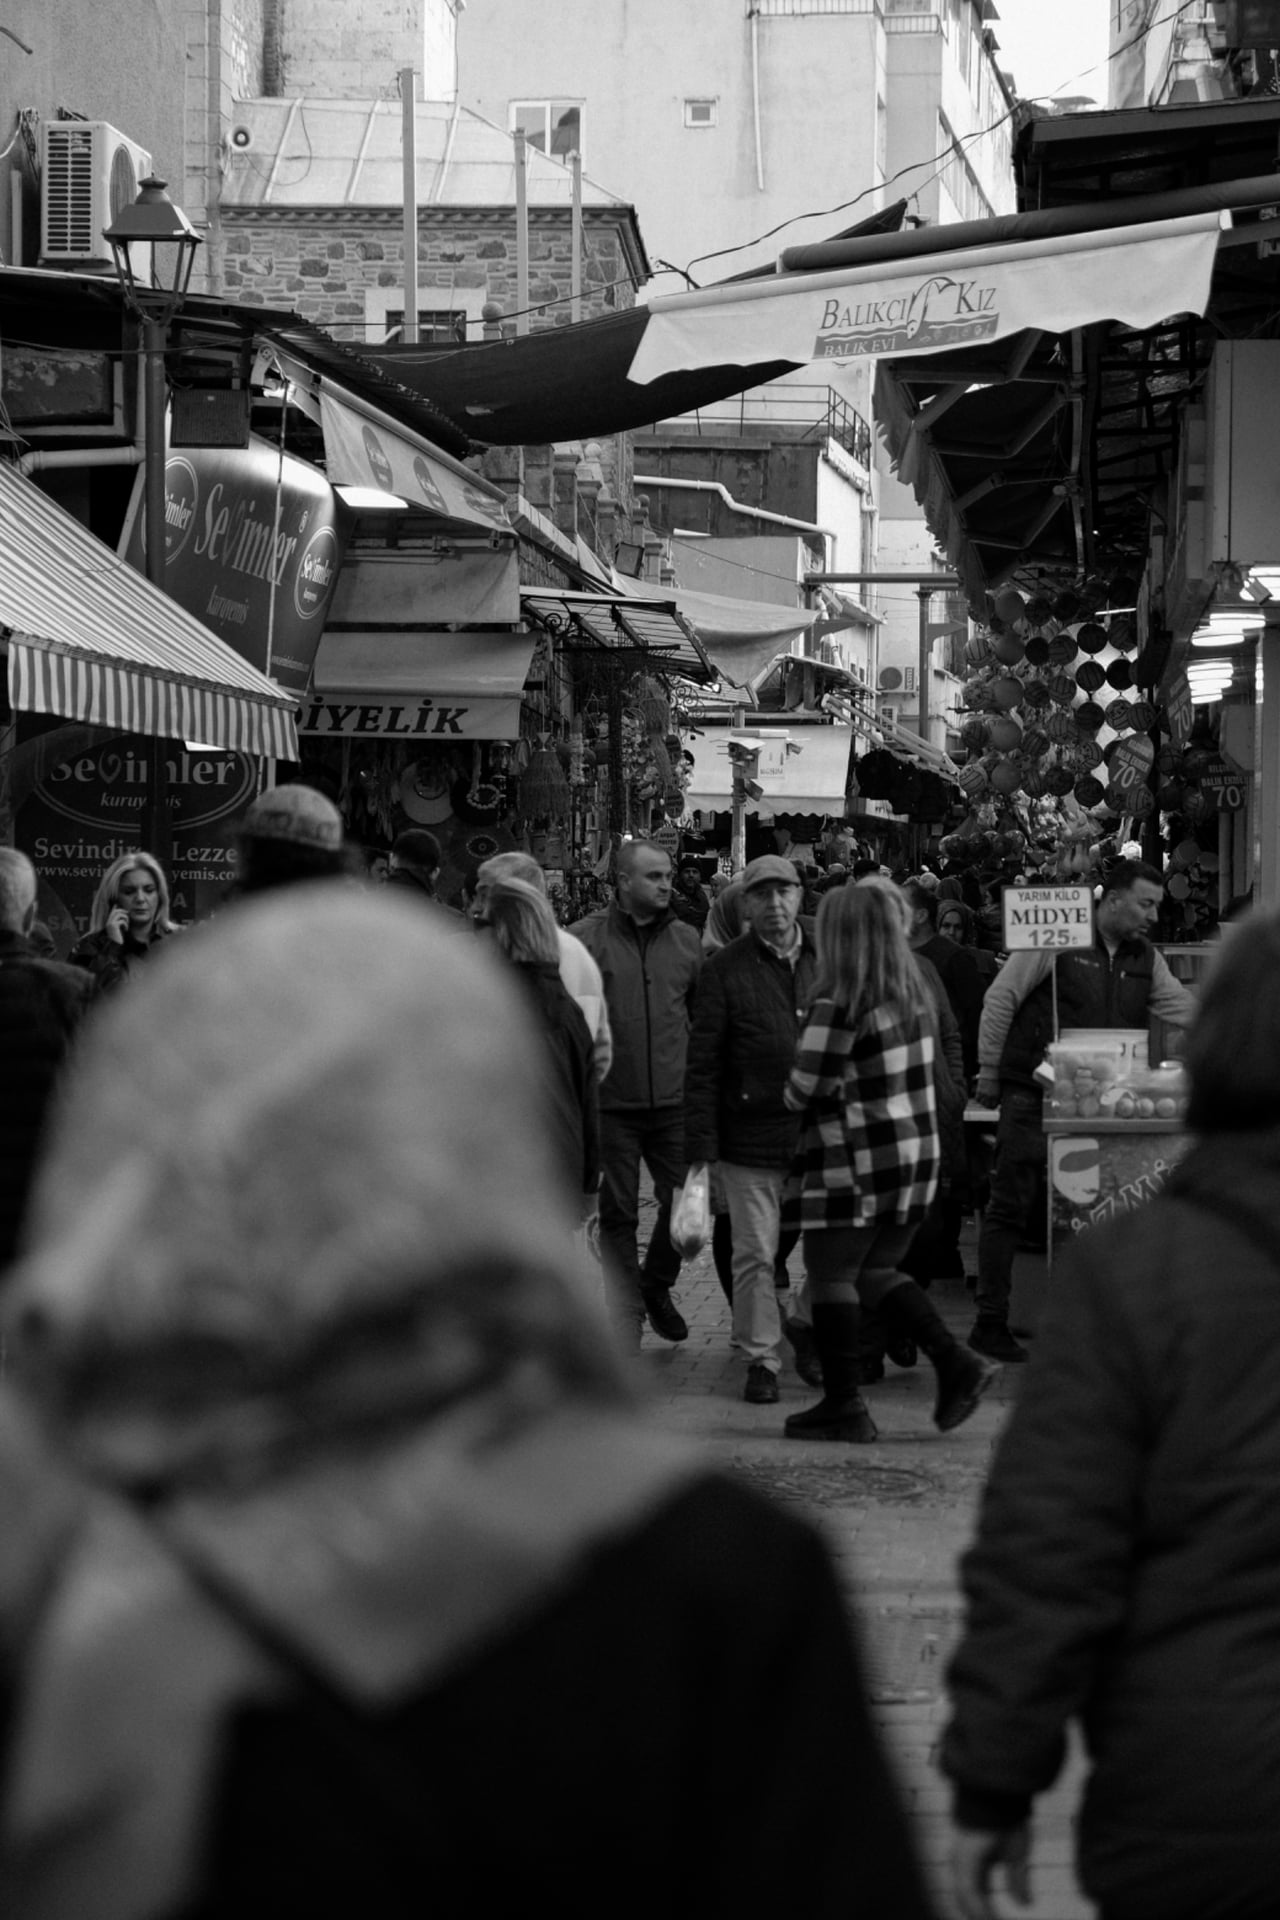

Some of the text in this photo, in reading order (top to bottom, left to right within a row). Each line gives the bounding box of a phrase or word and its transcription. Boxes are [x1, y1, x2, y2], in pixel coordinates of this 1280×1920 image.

[823, 336, 896, 357] BALIK EVİ
[165, 493, 193, 532] imler
[295, 695, 469, 734] İYELİK
[100, 792, 182, 811] kuruyis
[34, 837, 238, 863] Sevindir Lezze
[1017, 891, 1051, 902] YARIM
[1010, 904, 1089, 926] MİDYE
